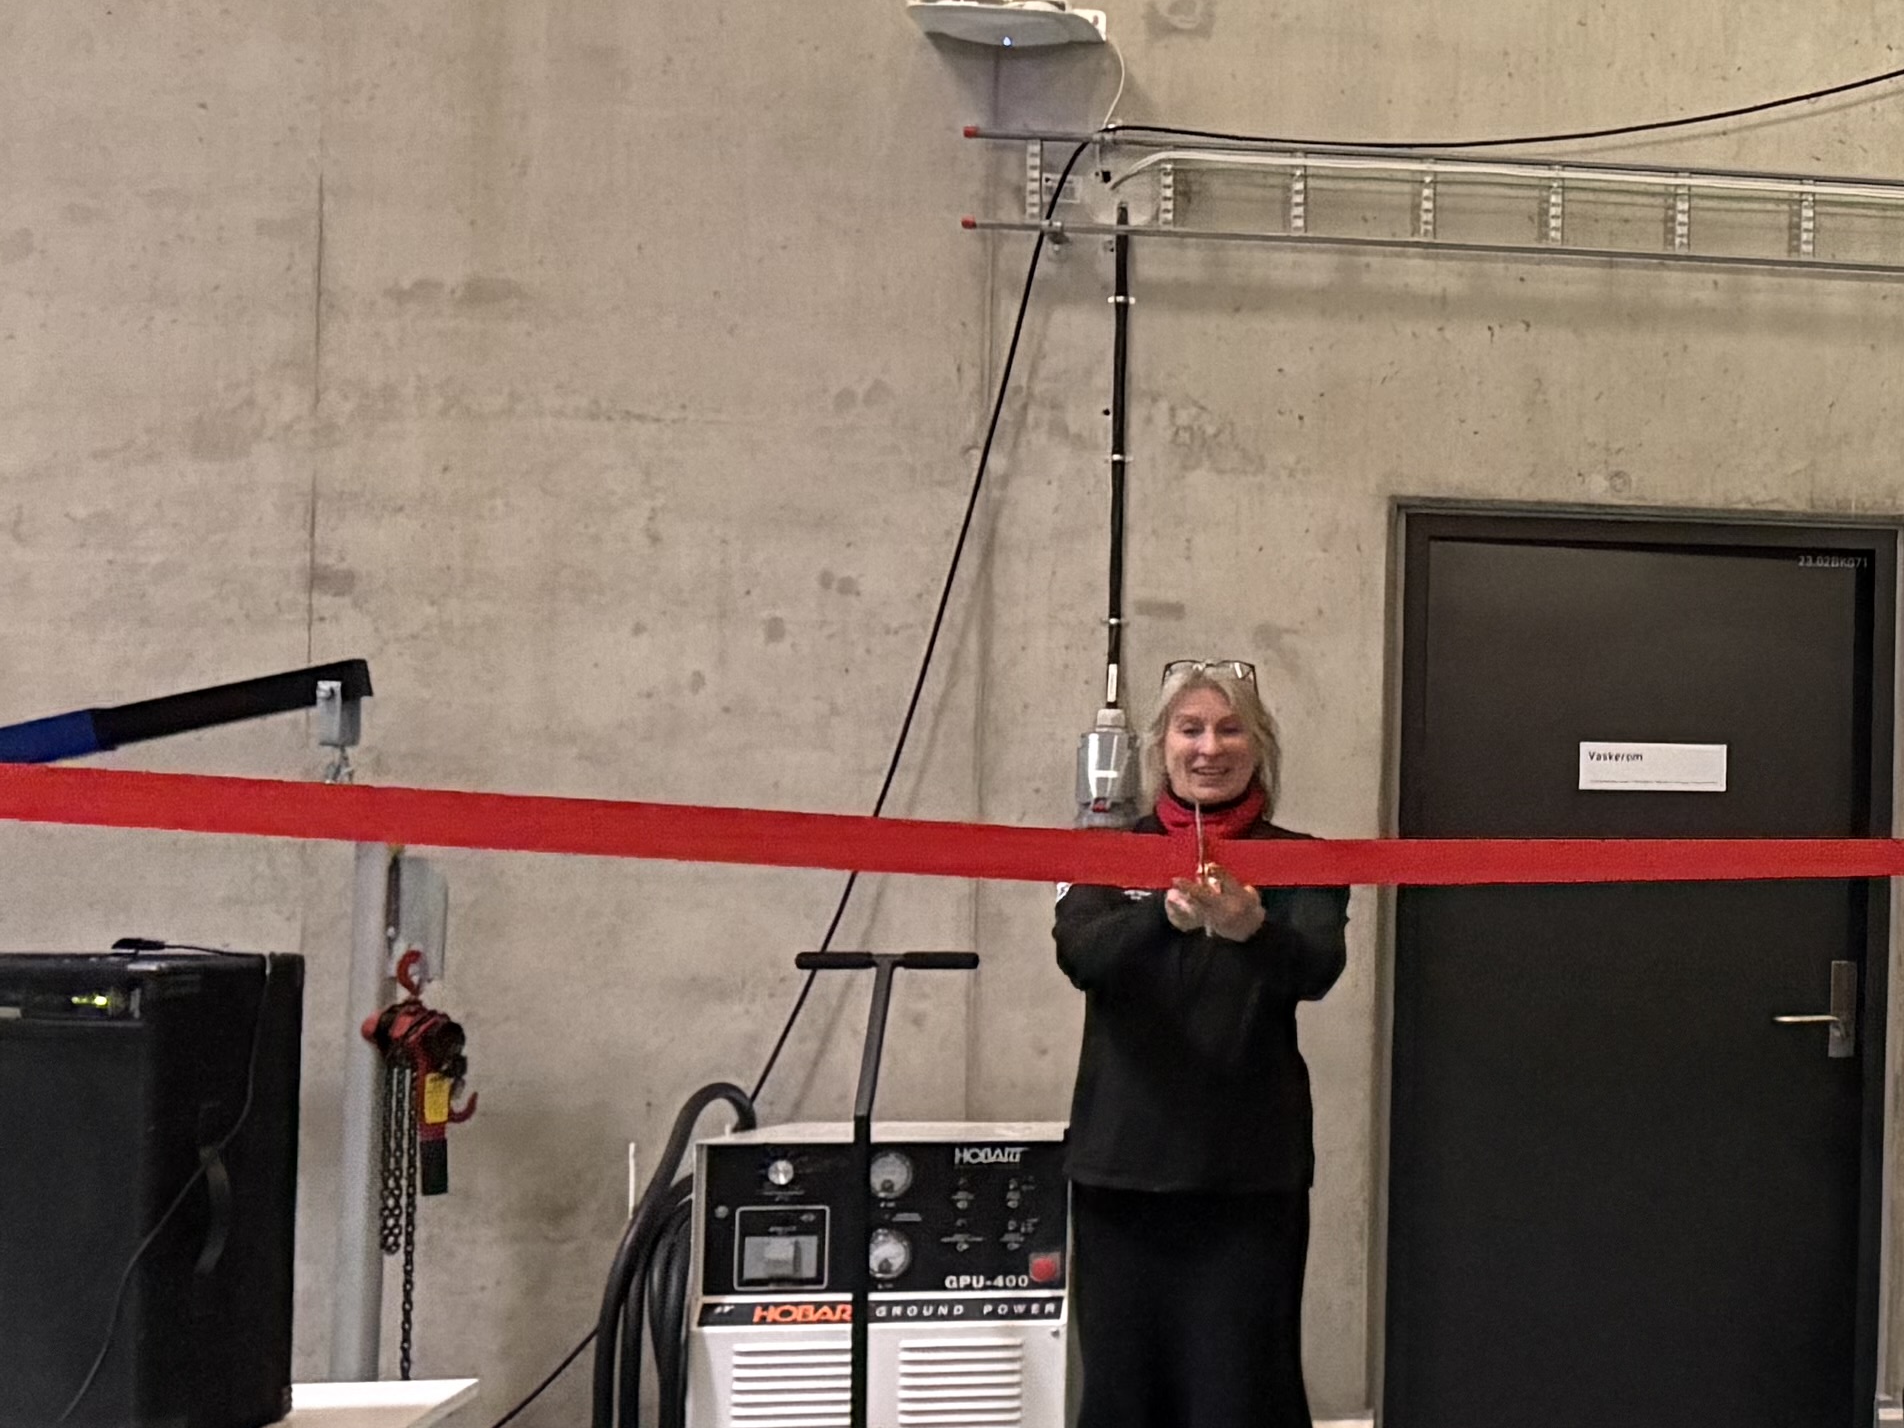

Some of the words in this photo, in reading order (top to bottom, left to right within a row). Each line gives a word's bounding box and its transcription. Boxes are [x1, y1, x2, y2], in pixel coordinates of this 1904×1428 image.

[1588, 751, 1643, 762] Vaskerom
[944, 1274, 1029, 1289] GPU-400
[752, 1304, 853, 1323] HOBAR
[875, 1304, 964, 1317] GROUND
[982, 1302, 1056, 1316] POWER
